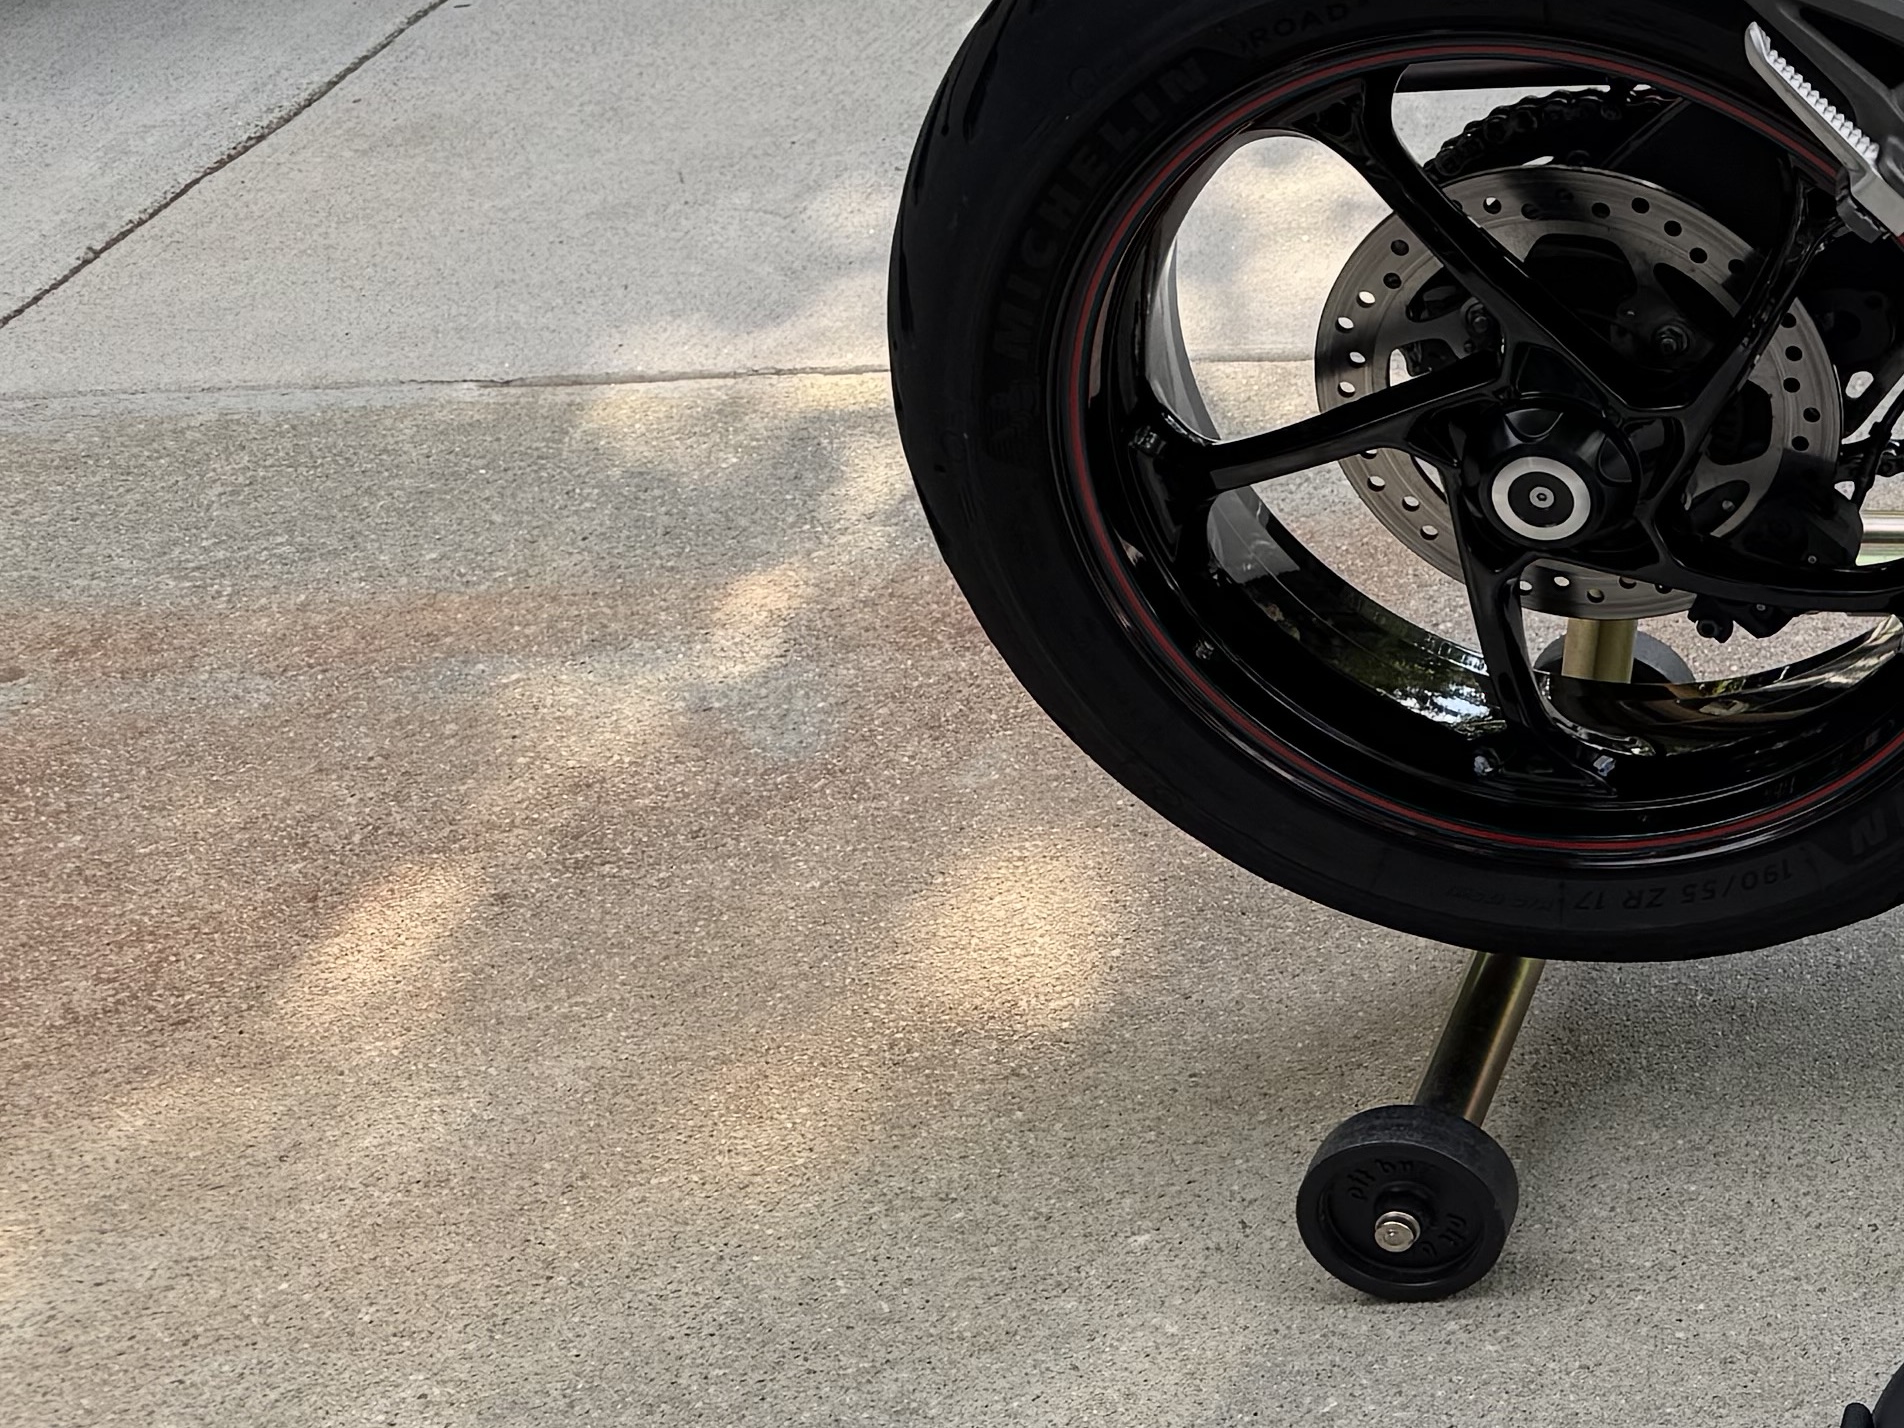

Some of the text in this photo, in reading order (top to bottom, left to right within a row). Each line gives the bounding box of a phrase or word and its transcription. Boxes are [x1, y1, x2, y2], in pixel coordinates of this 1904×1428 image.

[989, 56, 1212, 360] MICHELIN
[1248, 2, 1349, 50] ROAD
[1680, 858, 1793, 904] 190/55
[1573, 889, 1606, 911] 17
[1623, 887, 1667, 911] ZR
